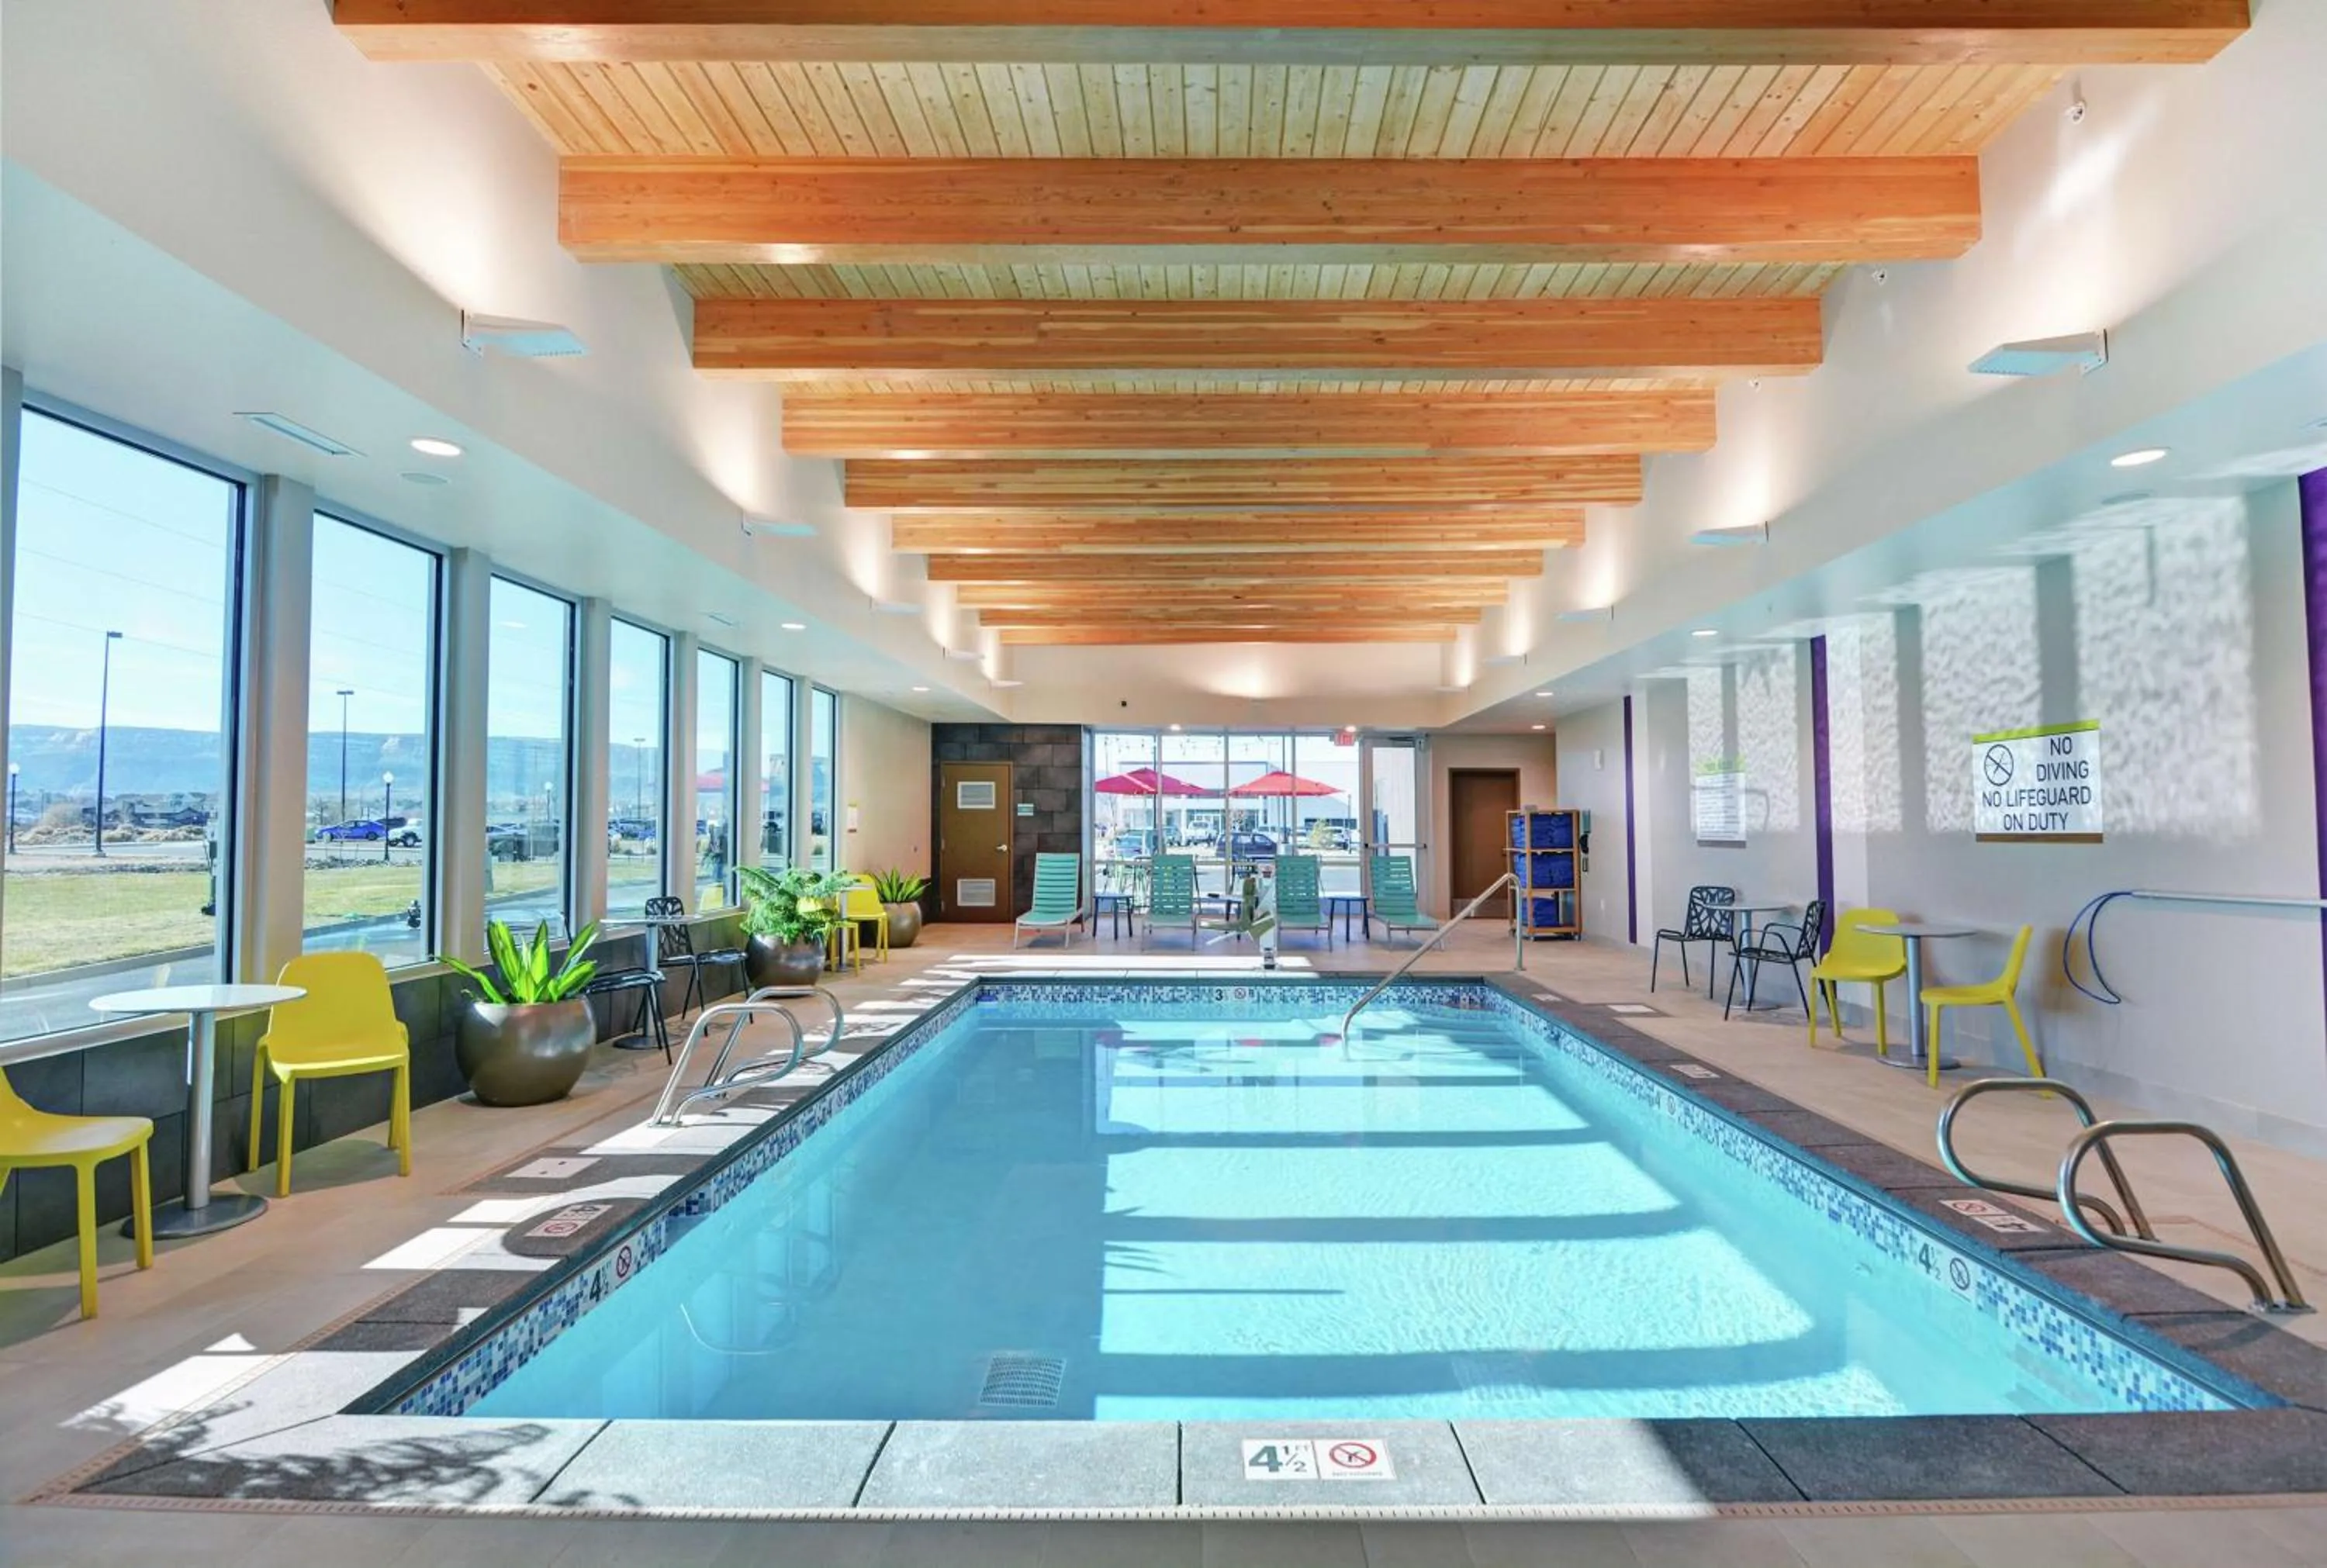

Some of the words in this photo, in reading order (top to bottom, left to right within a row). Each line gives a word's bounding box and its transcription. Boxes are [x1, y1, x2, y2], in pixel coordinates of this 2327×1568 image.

[2050, 736, 2073, 756] NO
[2036, 760, 2089, 782] DIVING
[1982, 789, 2002, 807] NO
[2007, 786, 2092, 807] LIFEGUARD
[2004, 813, 2024, 831] ON
[2028, 812, 2069, 831] DUTY
[1215, 989, 1223, 1001] 3
